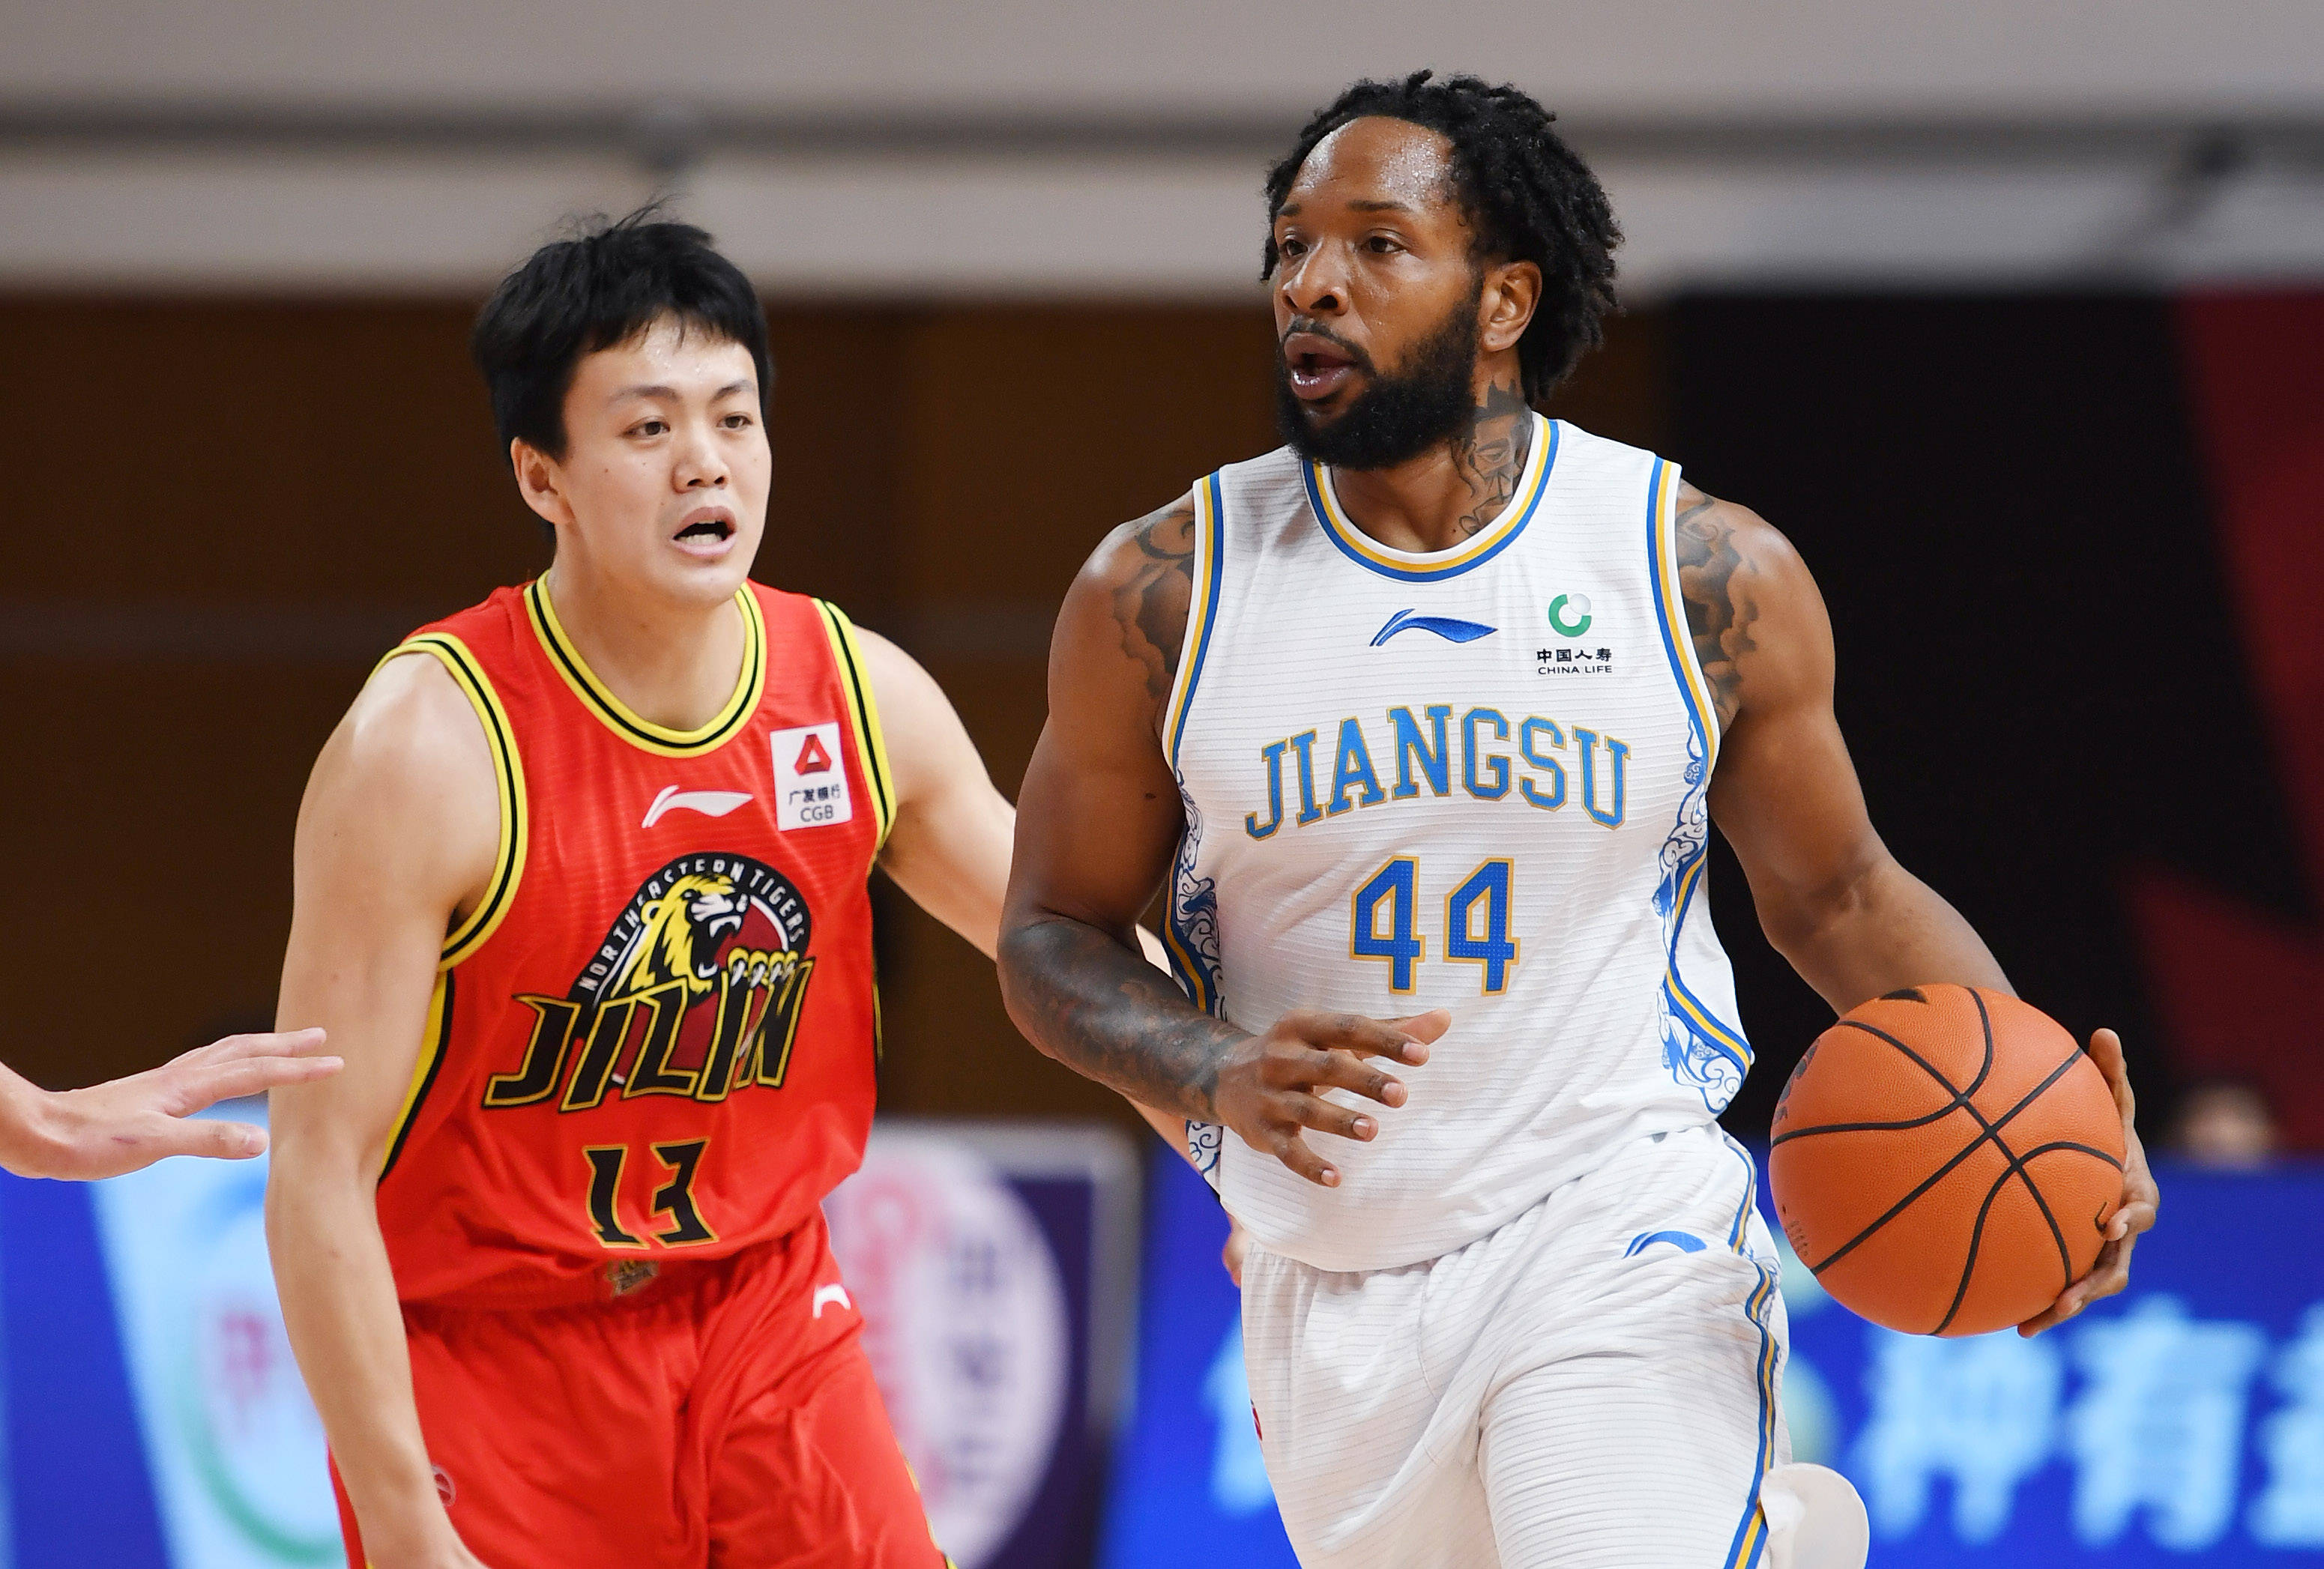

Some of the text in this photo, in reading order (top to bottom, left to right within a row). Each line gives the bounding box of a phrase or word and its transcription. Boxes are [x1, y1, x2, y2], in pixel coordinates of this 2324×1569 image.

[1536, 648, 1612, 664] 中国人寿
[1538, 665, 1612, 675] CHINA LIFE
[800, 805, 834, 823] CGB
[1245, 704, 1631, 842] JIANGSU
[749, 868, 805, 943] TIGERS
[1349, 855, 1519, 996] 44
[481, 958, 815, 1113] JILIN
[582, 1138, 720, 1250] 13
